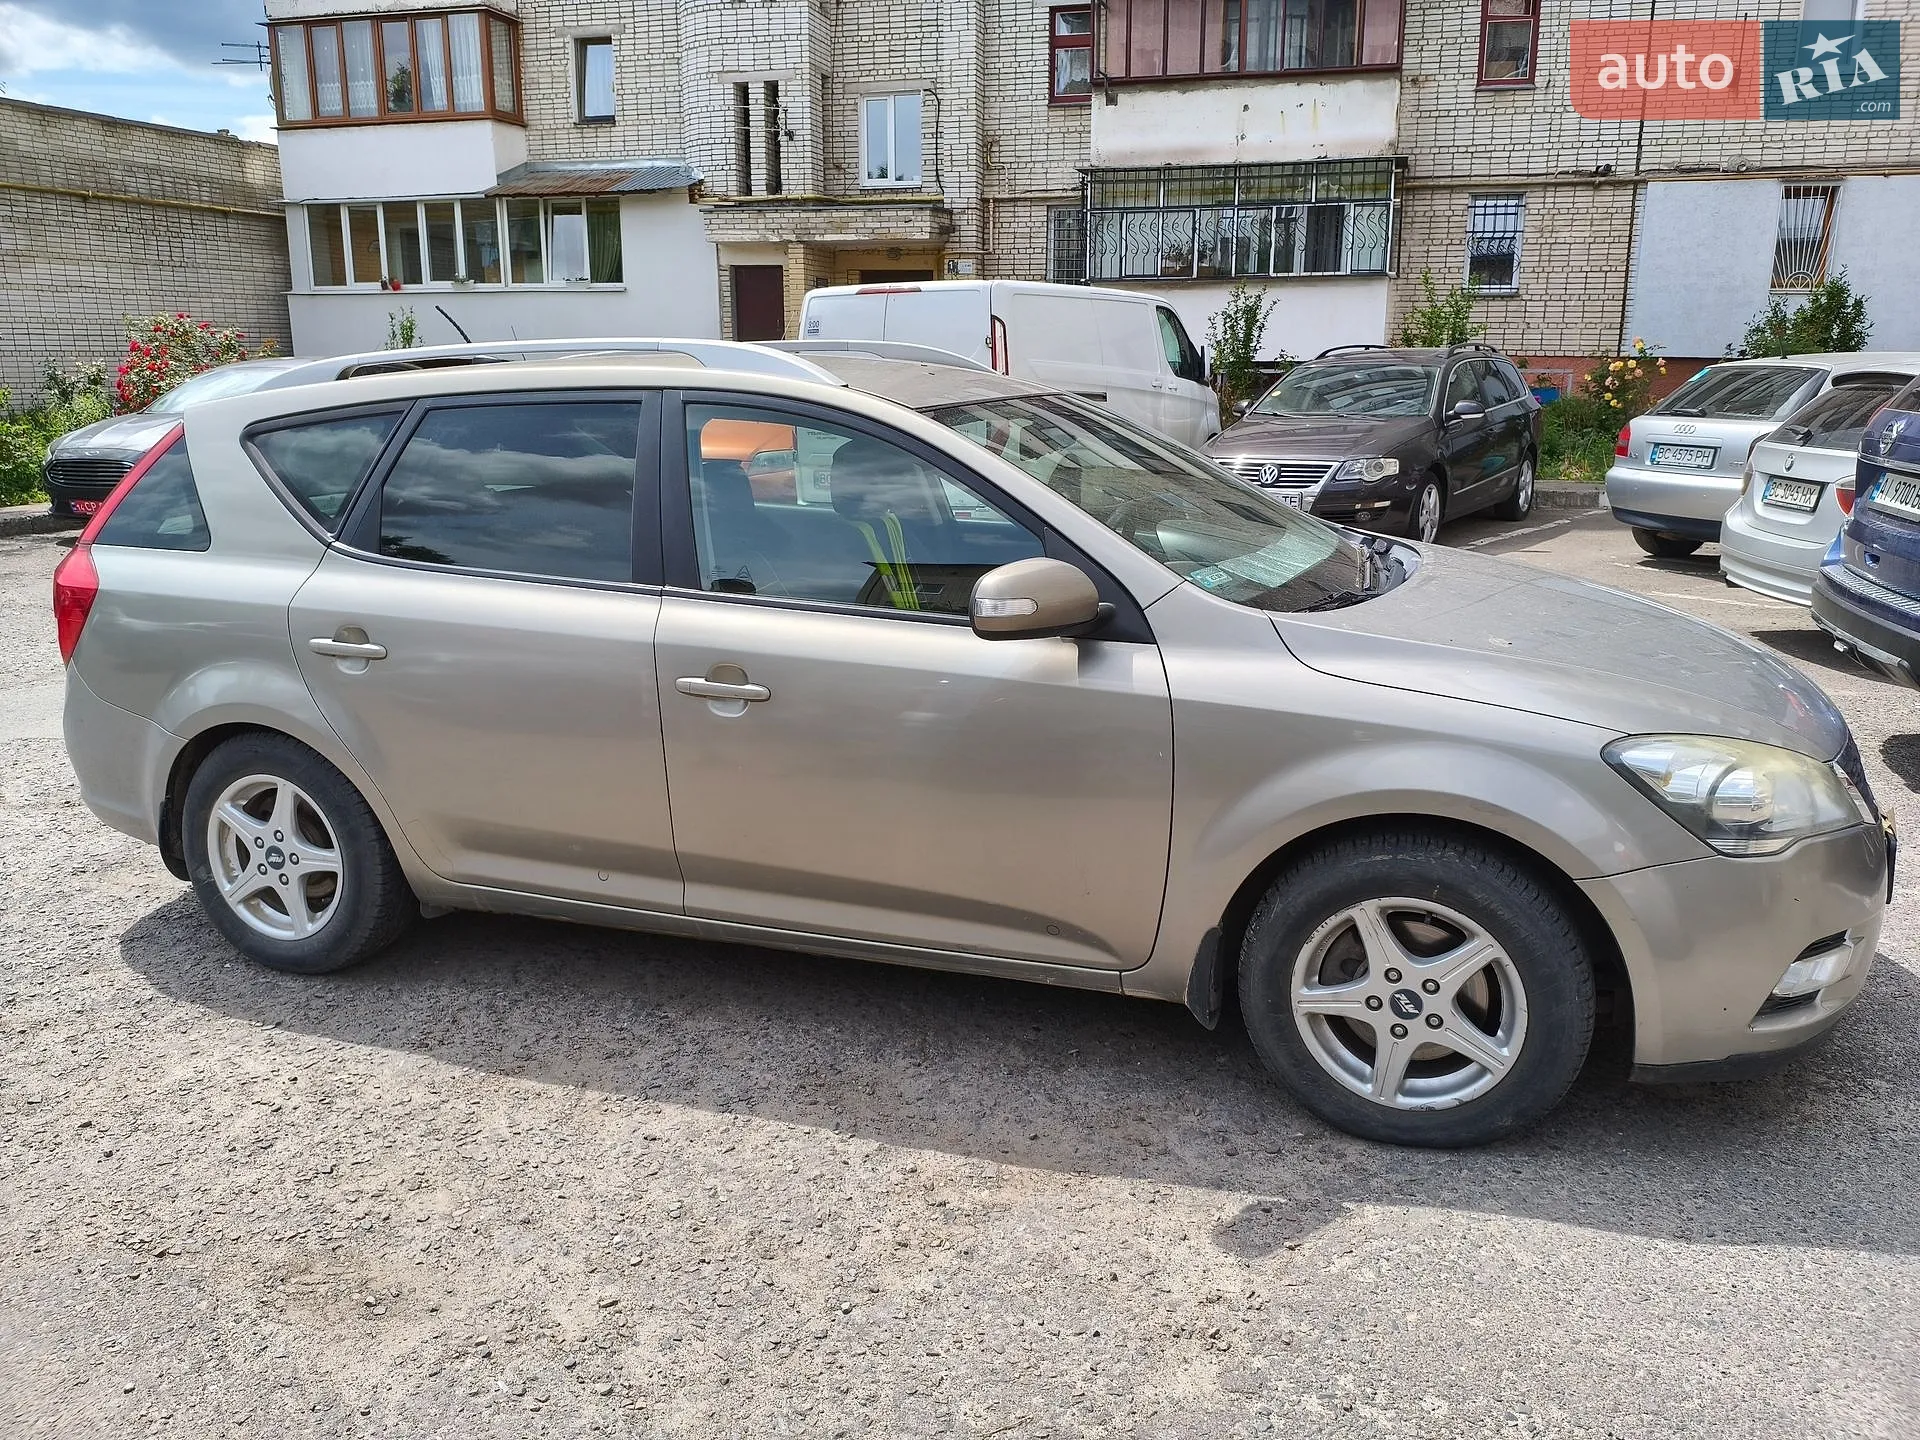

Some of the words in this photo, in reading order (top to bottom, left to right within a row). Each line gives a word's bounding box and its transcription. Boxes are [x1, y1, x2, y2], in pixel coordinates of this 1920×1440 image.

[1658, 447, 1671, 460] BC
[1672, 448, 1694, 461] 4575
[1695, 450, 1711, 463] PH
[1769, 482, 1782, 497] BC
[1800, 486, 1815, 504] HX
[1890, 481, 1916, 505] 9700
